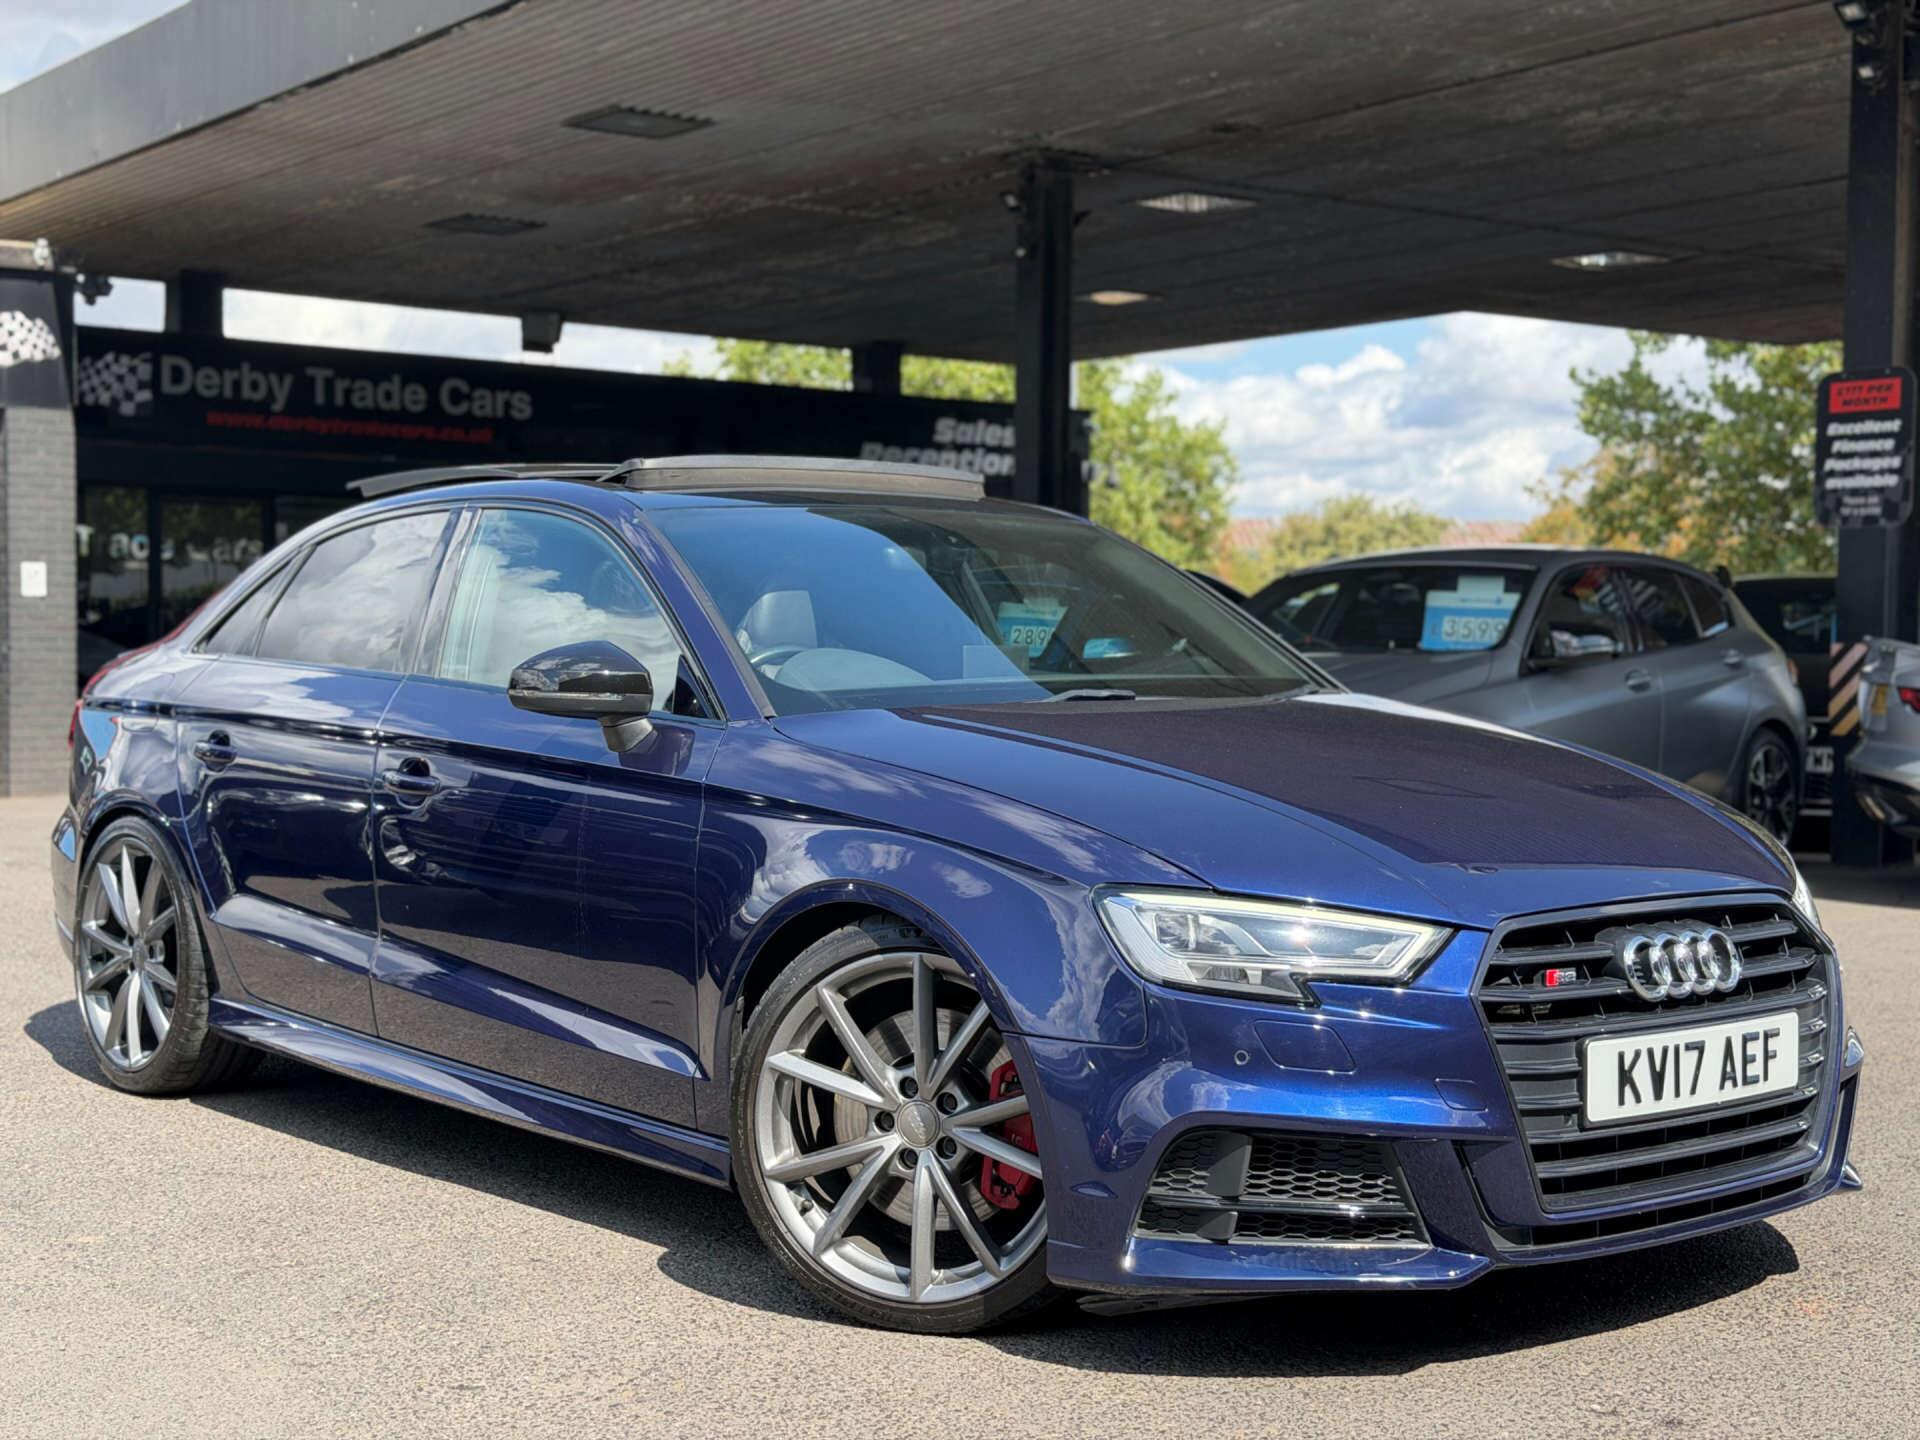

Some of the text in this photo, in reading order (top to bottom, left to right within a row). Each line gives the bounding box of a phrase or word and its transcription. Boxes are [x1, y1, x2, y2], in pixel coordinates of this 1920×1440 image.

[160, 354, 533, 422] Derby Trade Cars
[932, 416, 1016, 448] Sales
[1826, 418, 1902, 437] Excellent
[1617, 1027, 1782, 1106] KV17 AEF
